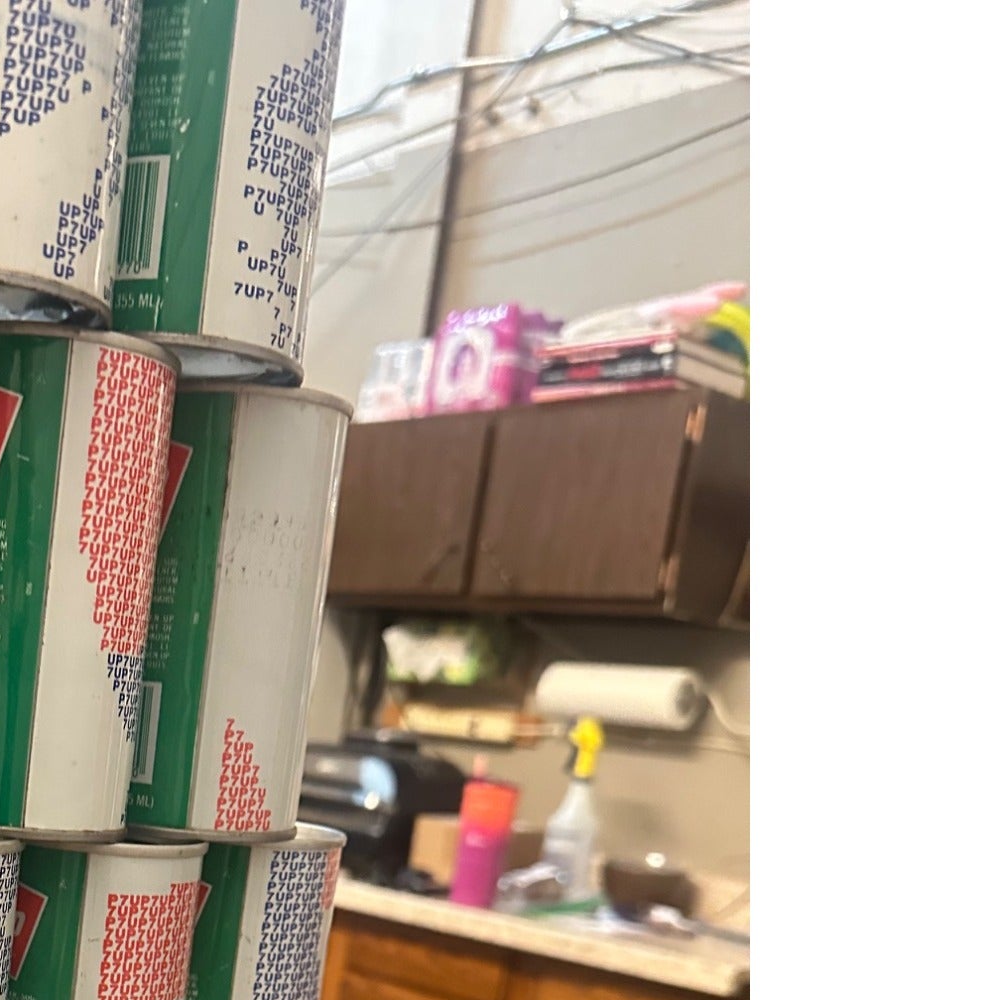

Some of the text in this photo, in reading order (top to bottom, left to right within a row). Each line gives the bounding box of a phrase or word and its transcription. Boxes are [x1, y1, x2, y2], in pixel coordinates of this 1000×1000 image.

[9, 11, 75, 39] 7UP7U
[7, 26, 86, 60] P7UP7U
[4, 59, 71, 86] P7UP7
[6, 43, 84, 74] 7UP7UP
[1, 91, 55, 113] P7UP
[4, 75, 70, 103] 7UP7U
[1, 107, 40, 125] 7UP
